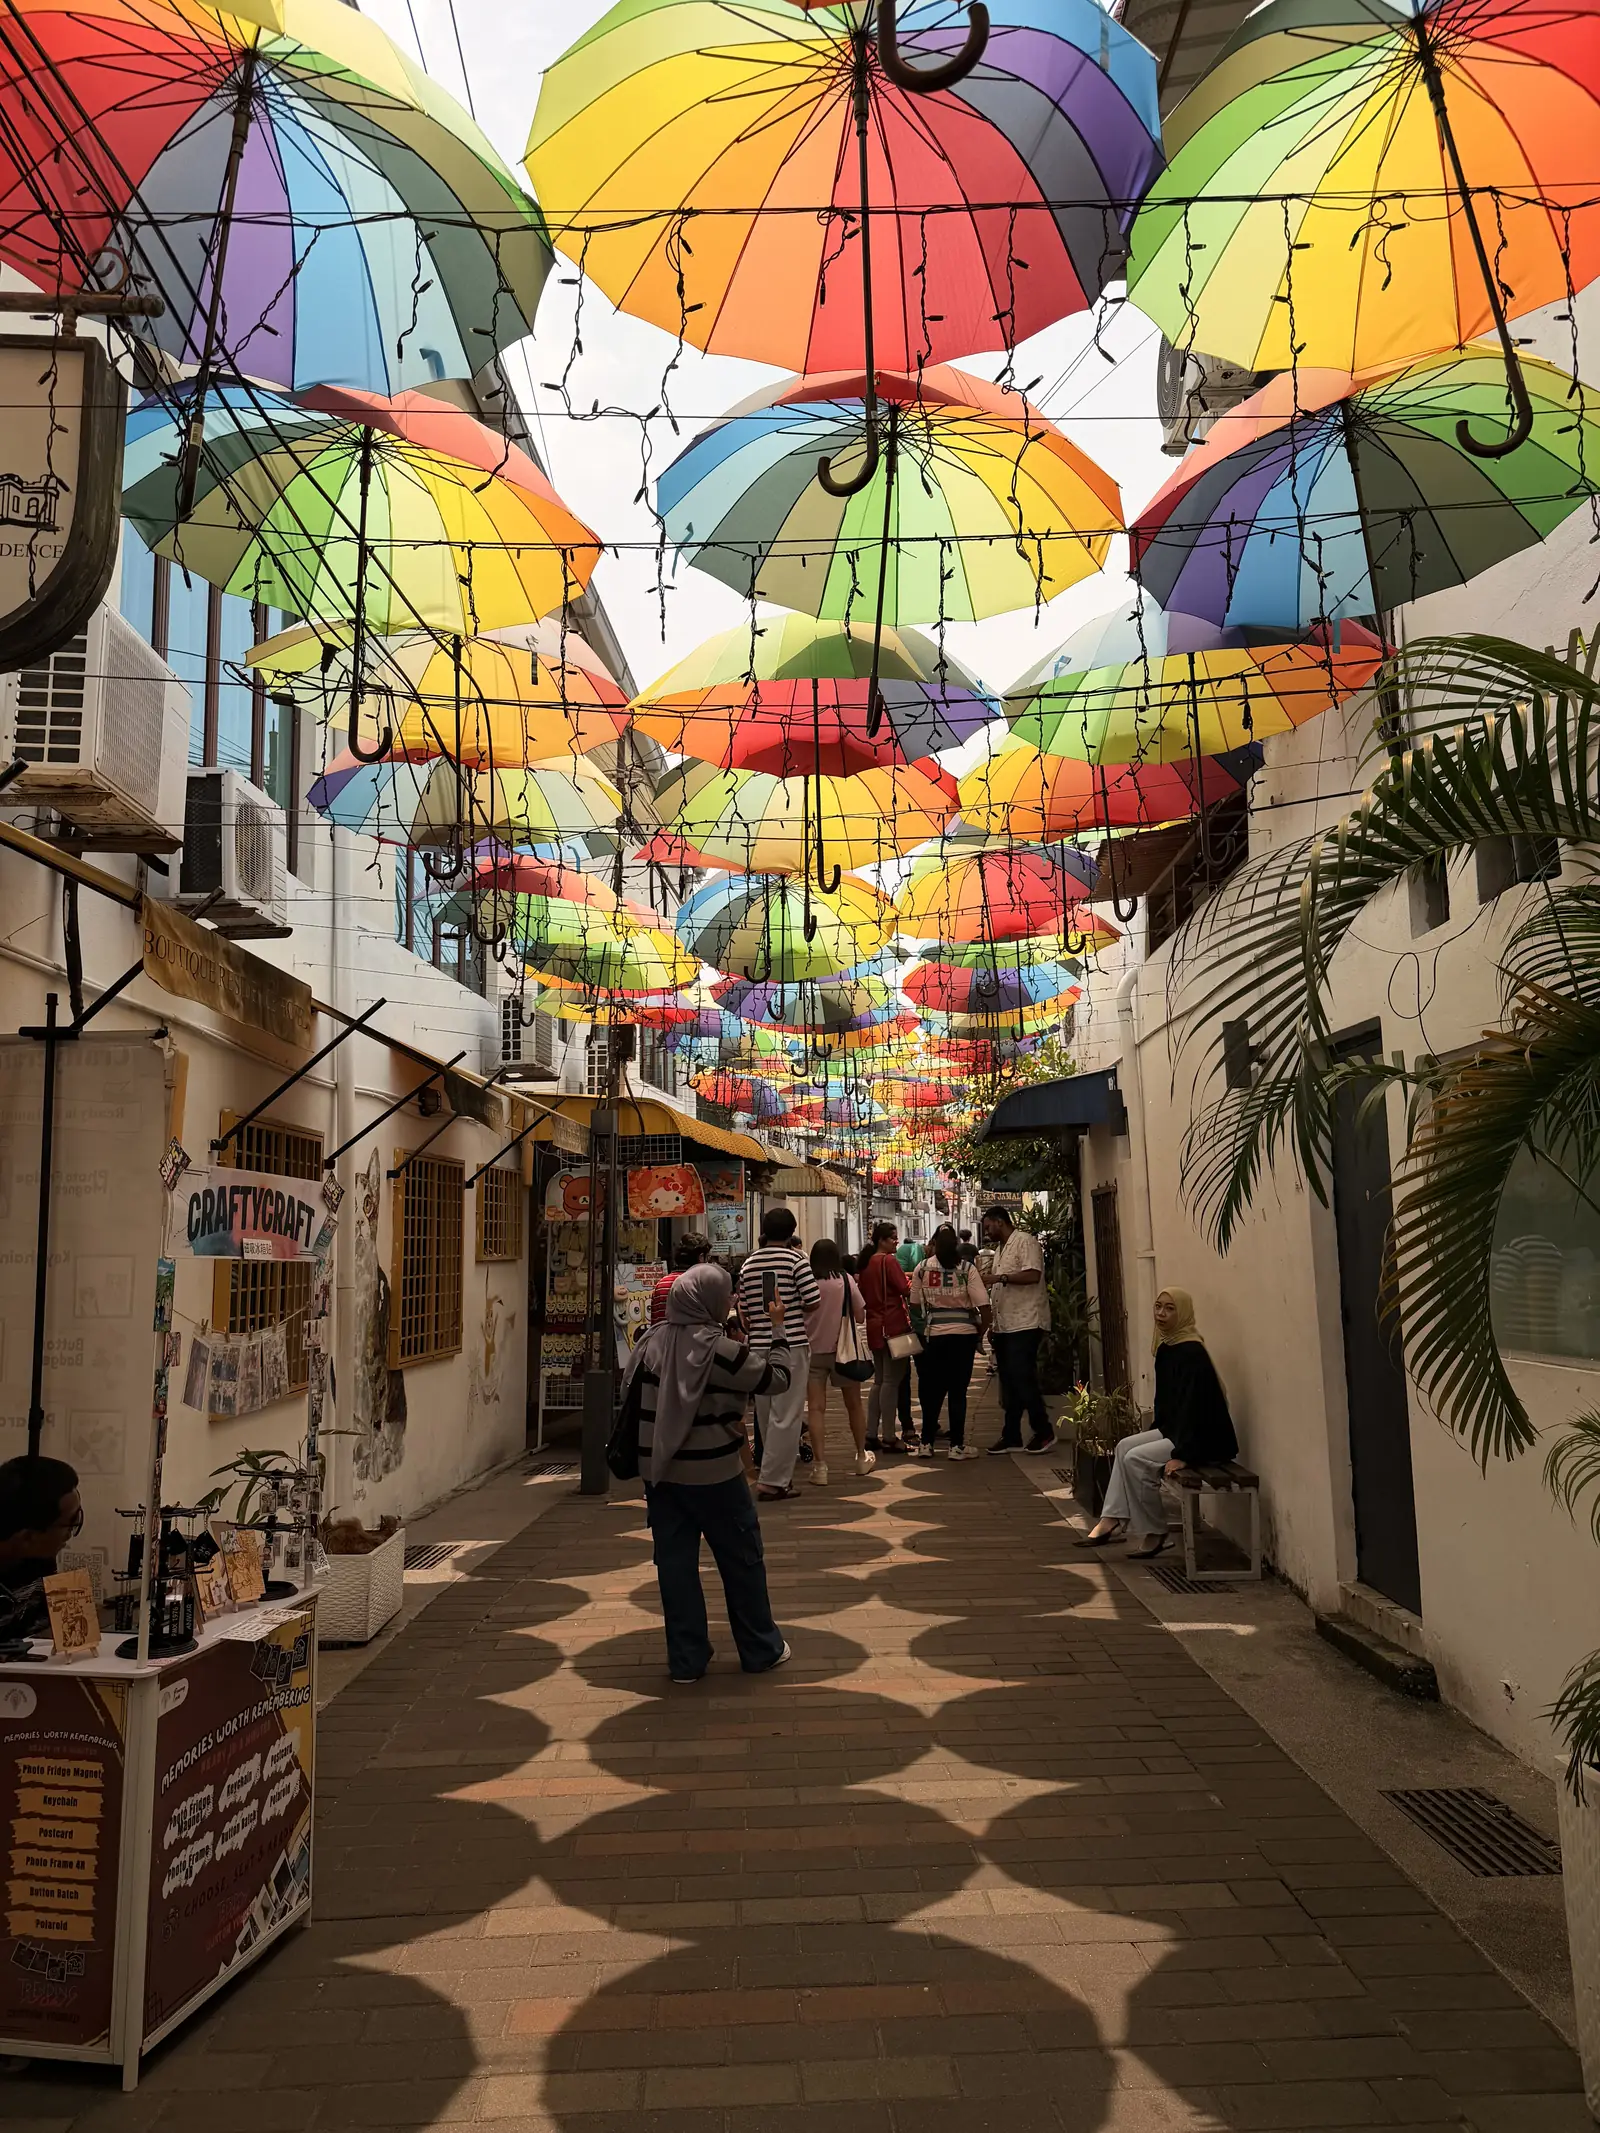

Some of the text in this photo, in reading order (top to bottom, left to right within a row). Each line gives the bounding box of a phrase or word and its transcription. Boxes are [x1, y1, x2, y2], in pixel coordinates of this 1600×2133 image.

[0, 543, 63, 558] DENCE
[144, 928, 216, 985] BOUTIQUE
[187, 1185, 315, 1248] CRAFTYCRAFT
[185, 1603, 193, 1630] ANWAR
[3, 1731, 118, 1750] MEMORIES WORTH REMEMBERING
[161, 1686, 310, 1794] MEMORIES WORTH REMEMBERING
[22, 1763, 102, 1779] Photo Fridge Magnet
[43, 1795, 78, 1808] Keychain
[38, 1827, 74, 1840] Postcard
[25, 1856, 86, 1871] Photo Frame 4R
[29, 1886, 79, 1900] Button Batch
[35, 1919, 68, 1931] Polaroid
[17, 1978, 78, 1998] TRENDING
